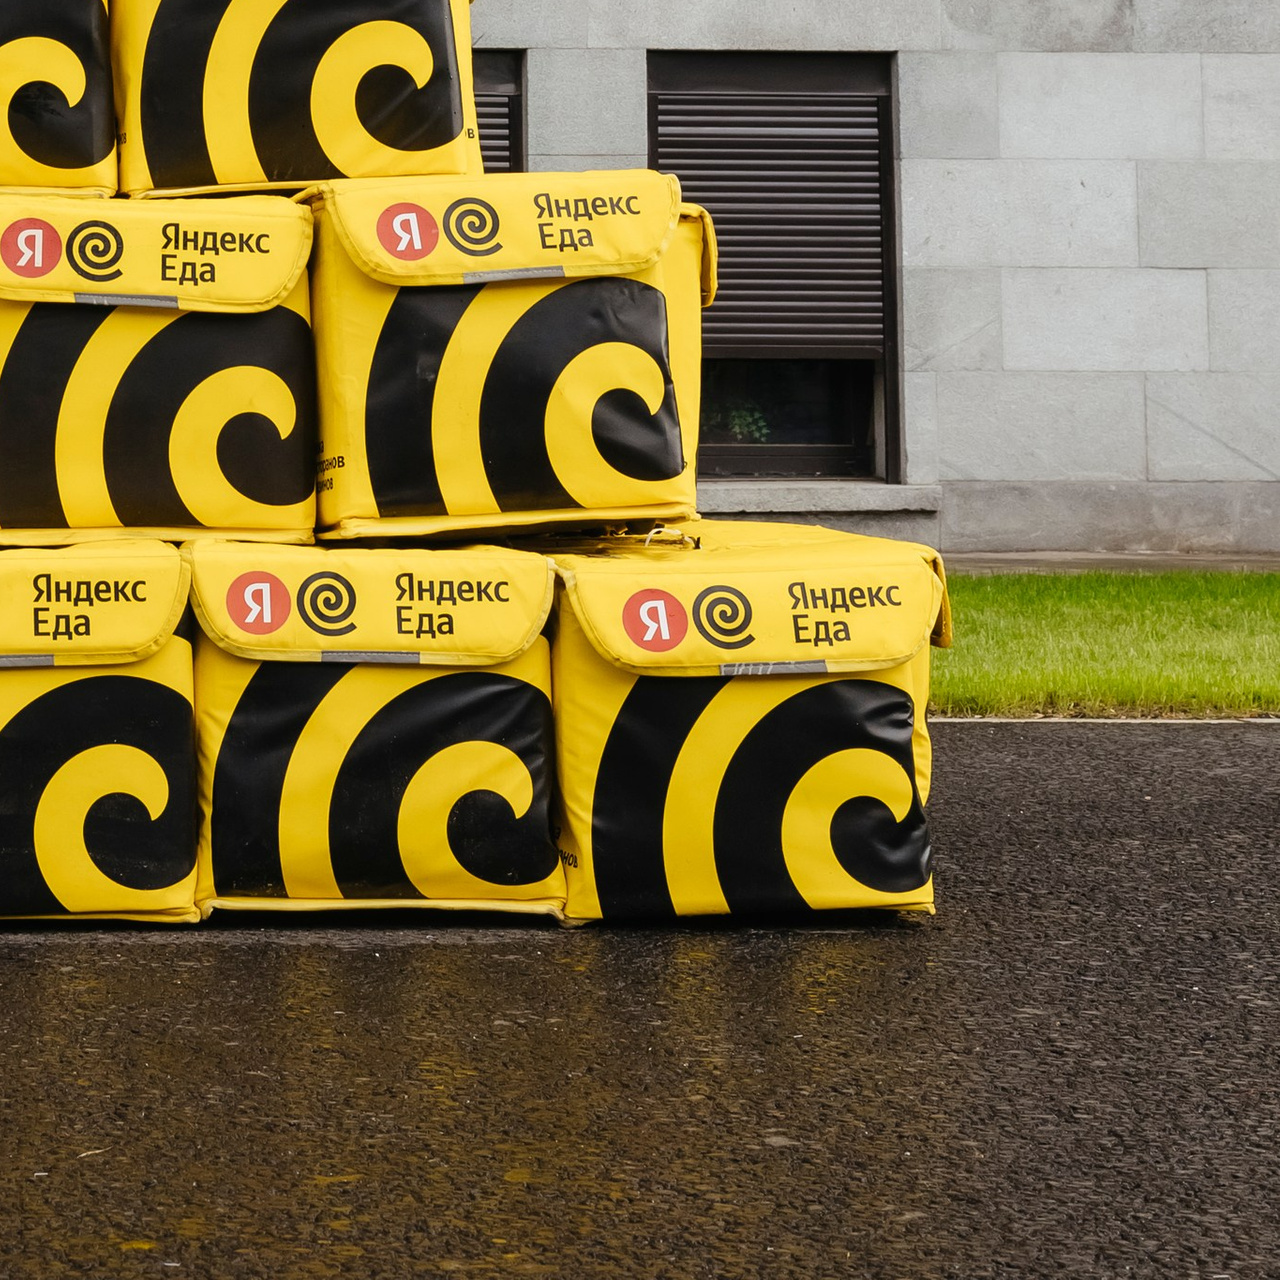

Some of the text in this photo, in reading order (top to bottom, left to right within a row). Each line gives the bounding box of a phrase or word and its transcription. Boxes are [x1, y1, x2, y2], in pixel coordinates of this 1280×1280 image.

[534, 194, 640, 221] Яндекс
[162, 223, 269, 255] Яндекс
[539, 223, 593, 252] Еда
[162, 254, 215, 286] Еда
[33, 574, 146, 606] Яндекс
[396, 573, 509, 605] Яндекс
[789, 582, 901, 612] Яндекс
[34, 608, 90, 640] Еда
[397, 606, 453, 638] Еда
[793, 615, 850, 646] Еда
